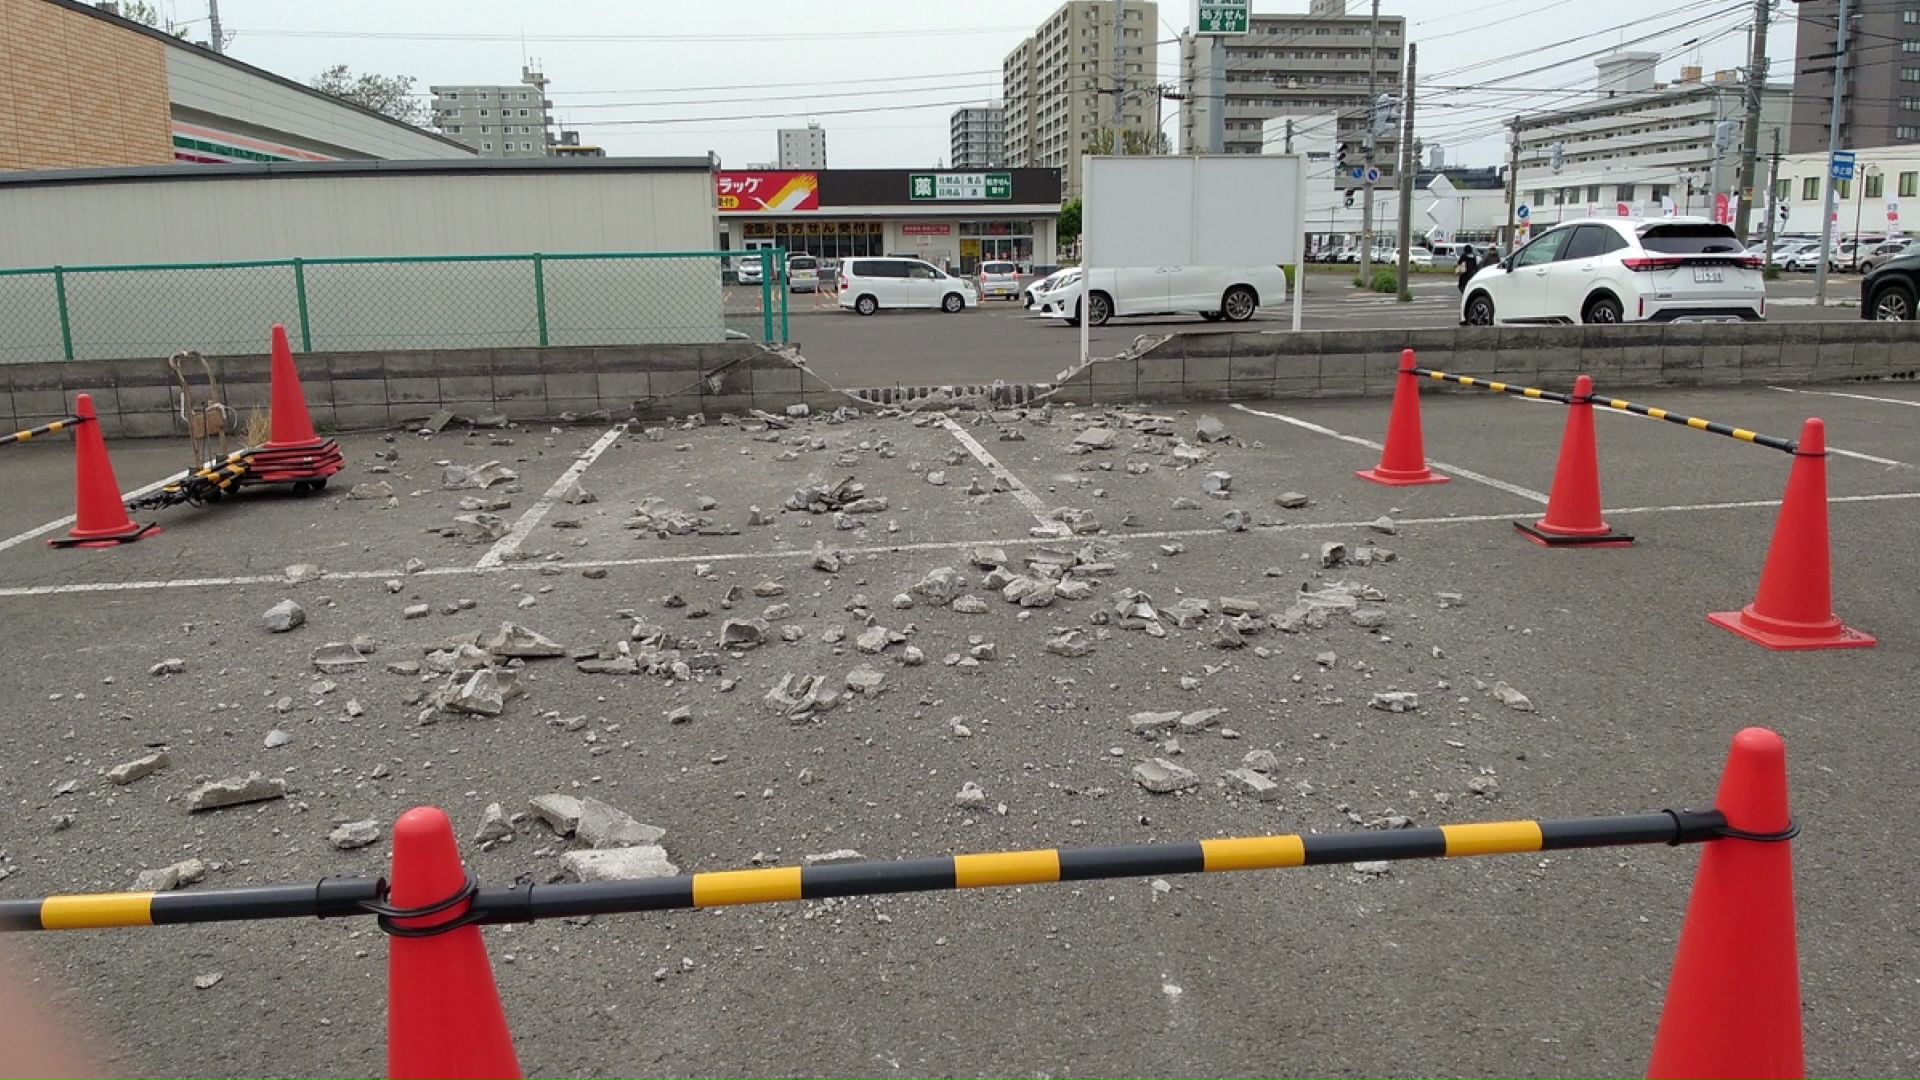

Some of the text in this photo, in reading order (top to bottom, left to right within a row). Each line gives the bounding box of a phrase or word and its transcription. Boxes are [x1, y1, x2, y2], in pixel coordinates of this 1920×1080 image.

[1202, 9, 1245, 20] 処方せん
[1211, 20, 1236, 31] 受付
[939, 176, 960, 185] 化粧品
[915, 177, 931, 196] 薬
